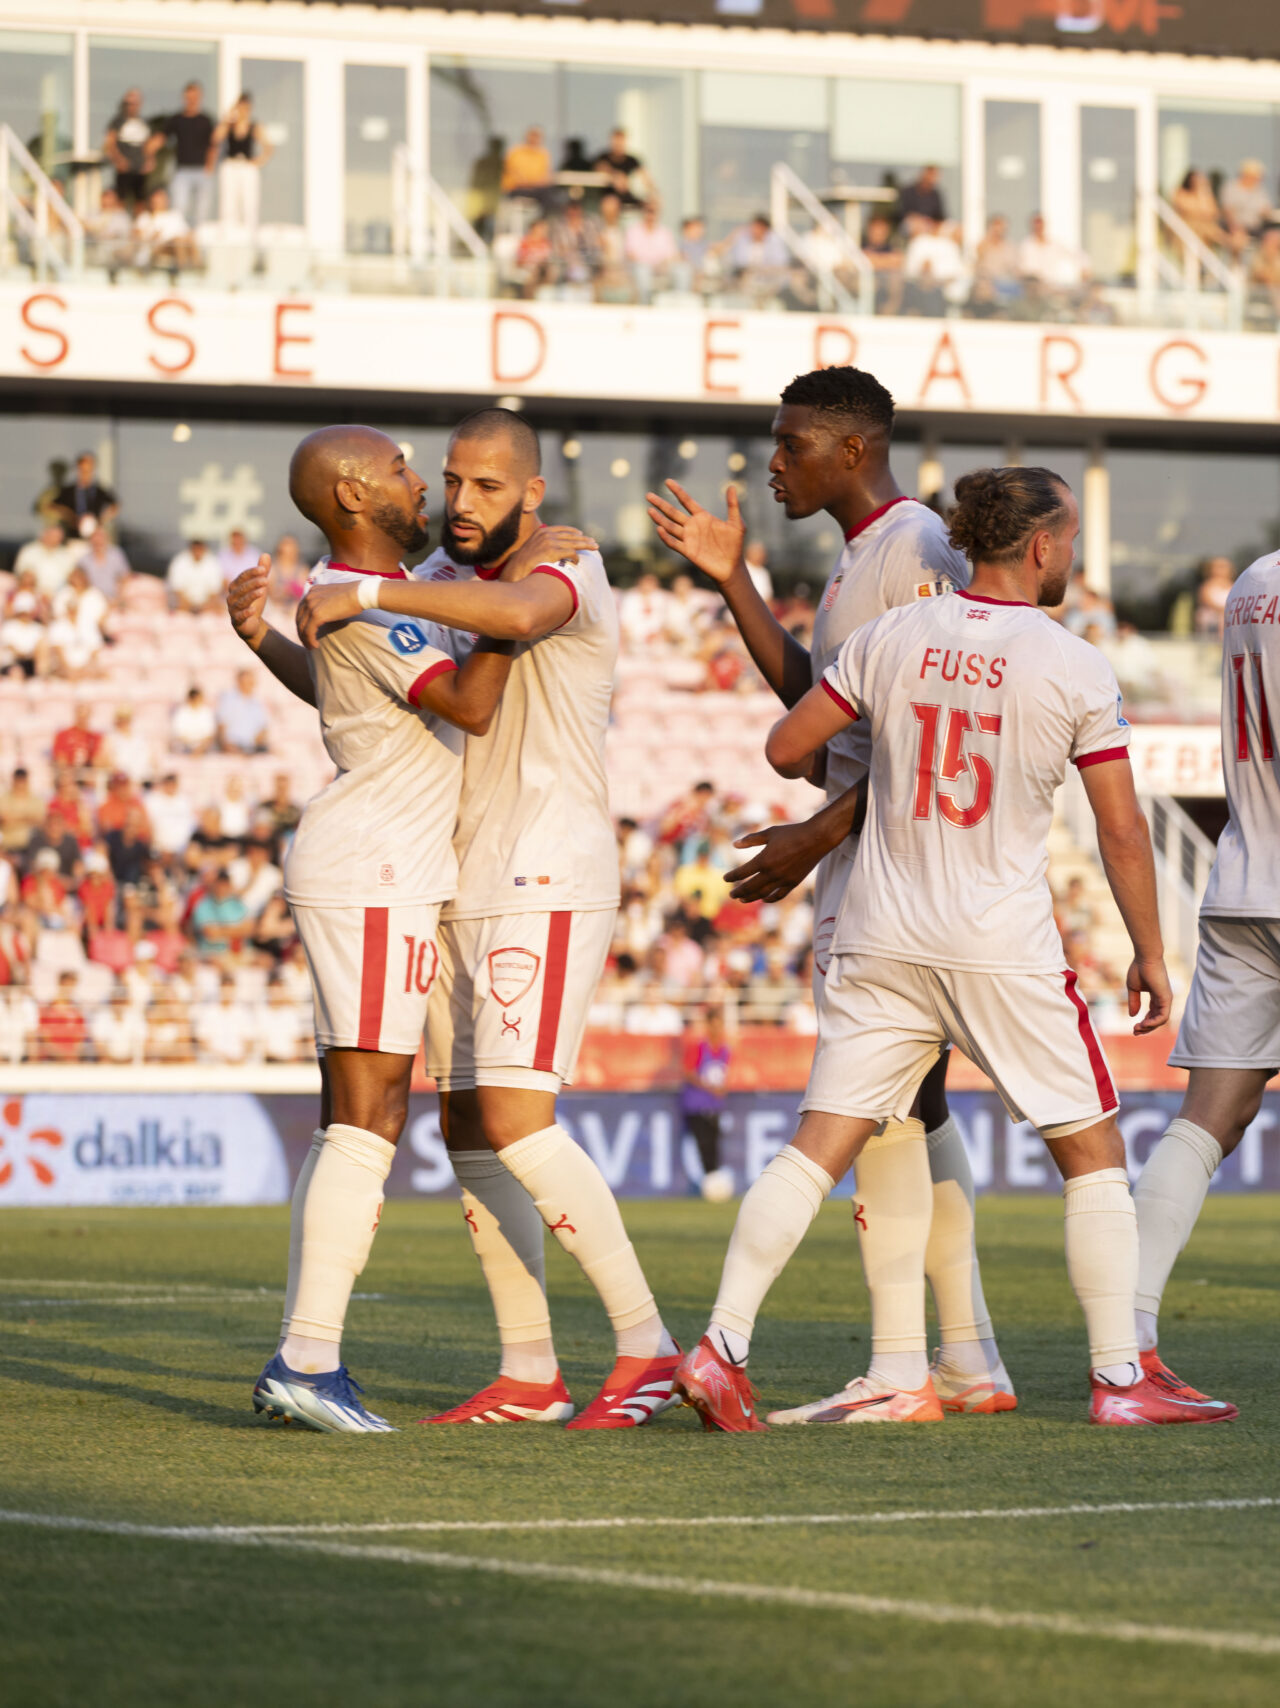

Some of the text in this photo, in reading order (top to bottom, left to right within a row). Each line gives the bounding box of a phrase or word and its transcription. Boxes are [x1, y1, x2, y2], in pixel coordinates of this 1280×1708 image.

[19, 291, 314, 378] SSE
[491, 309, 549, 385] D
[919, 647, 1007, 689] FUSS
[1231, 652, 1275, 763] 11
[909, 701, 1003, 830] 15
[402, 934, 440, 995] 10
[73, 1117, 224, 1170] dalkia
